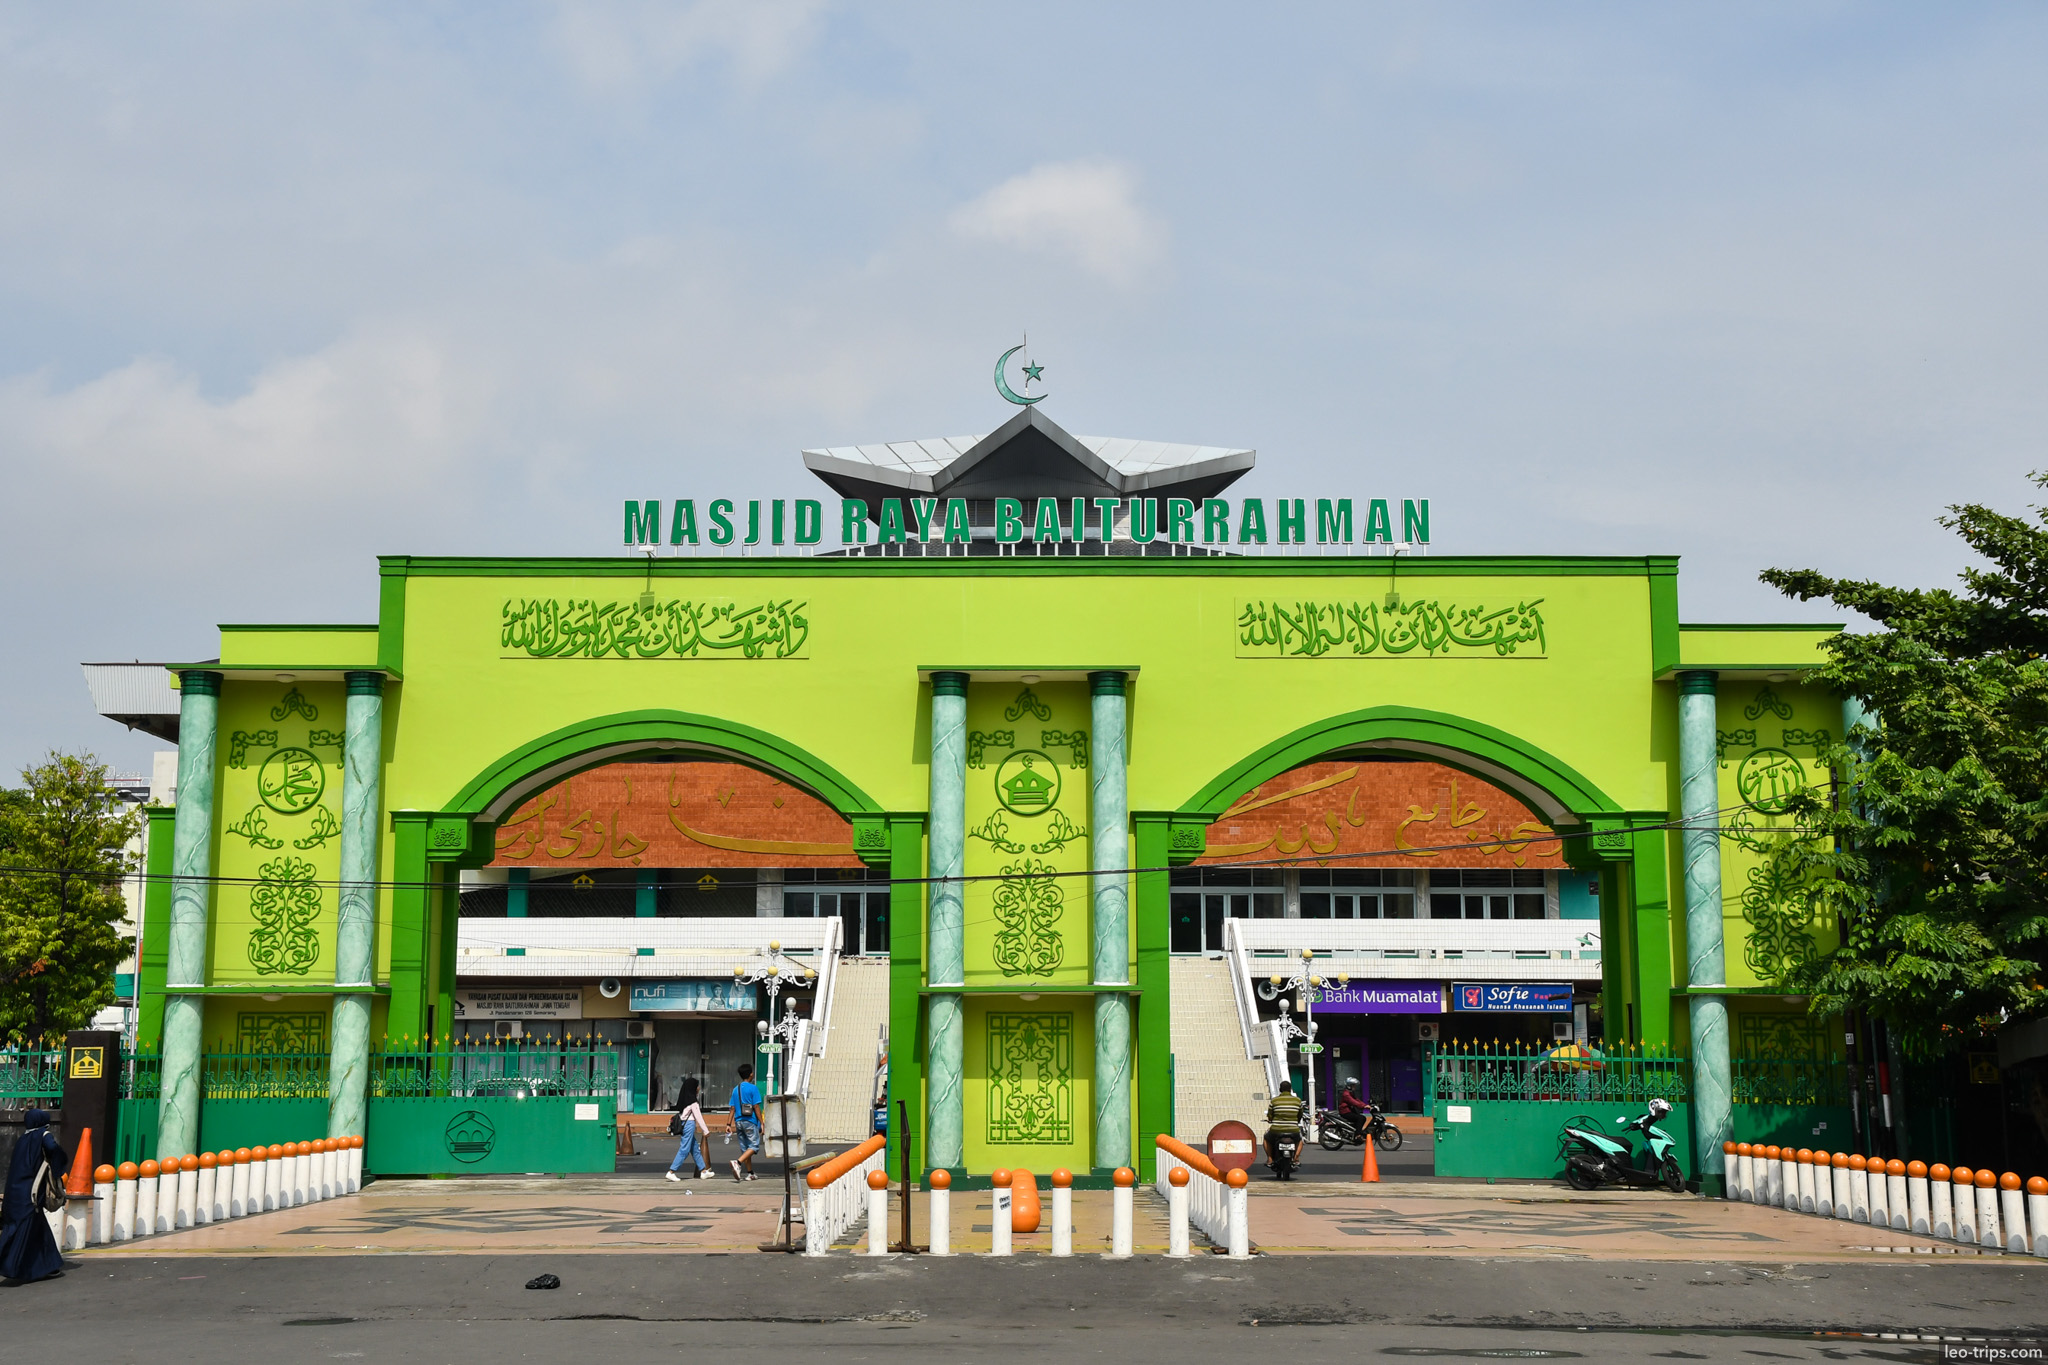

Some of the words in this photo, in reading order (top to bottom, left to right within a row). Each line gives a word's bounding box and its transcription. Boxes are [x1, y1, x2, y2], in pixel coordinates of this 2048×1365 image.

[623, 498, 823, 547] MASJID
[841, 497, 971, 546] RAYA
[994, 496, 1431, 545] BAITURRAHMAN
[468, 993, 487, 1001] YAYASAN
[487, 993, 501, 1001] PUSAT
[502, 993, 518, 1001] KAJIAN
[518, 993, 527, 1001] DAN
[529, 993, 564, 1001] PENGEMBANGAN
[564, 993, 579, 1001] ISLAM
[635, 984, 665, 998] nufi
[1325, 989, 1361, 1003] Bank
[1363, 989, 1438, 1003] Muamalat
[1487, 986, 1529, 1004] Sofie
[553, 1001, 570, 1009] TENGAH
